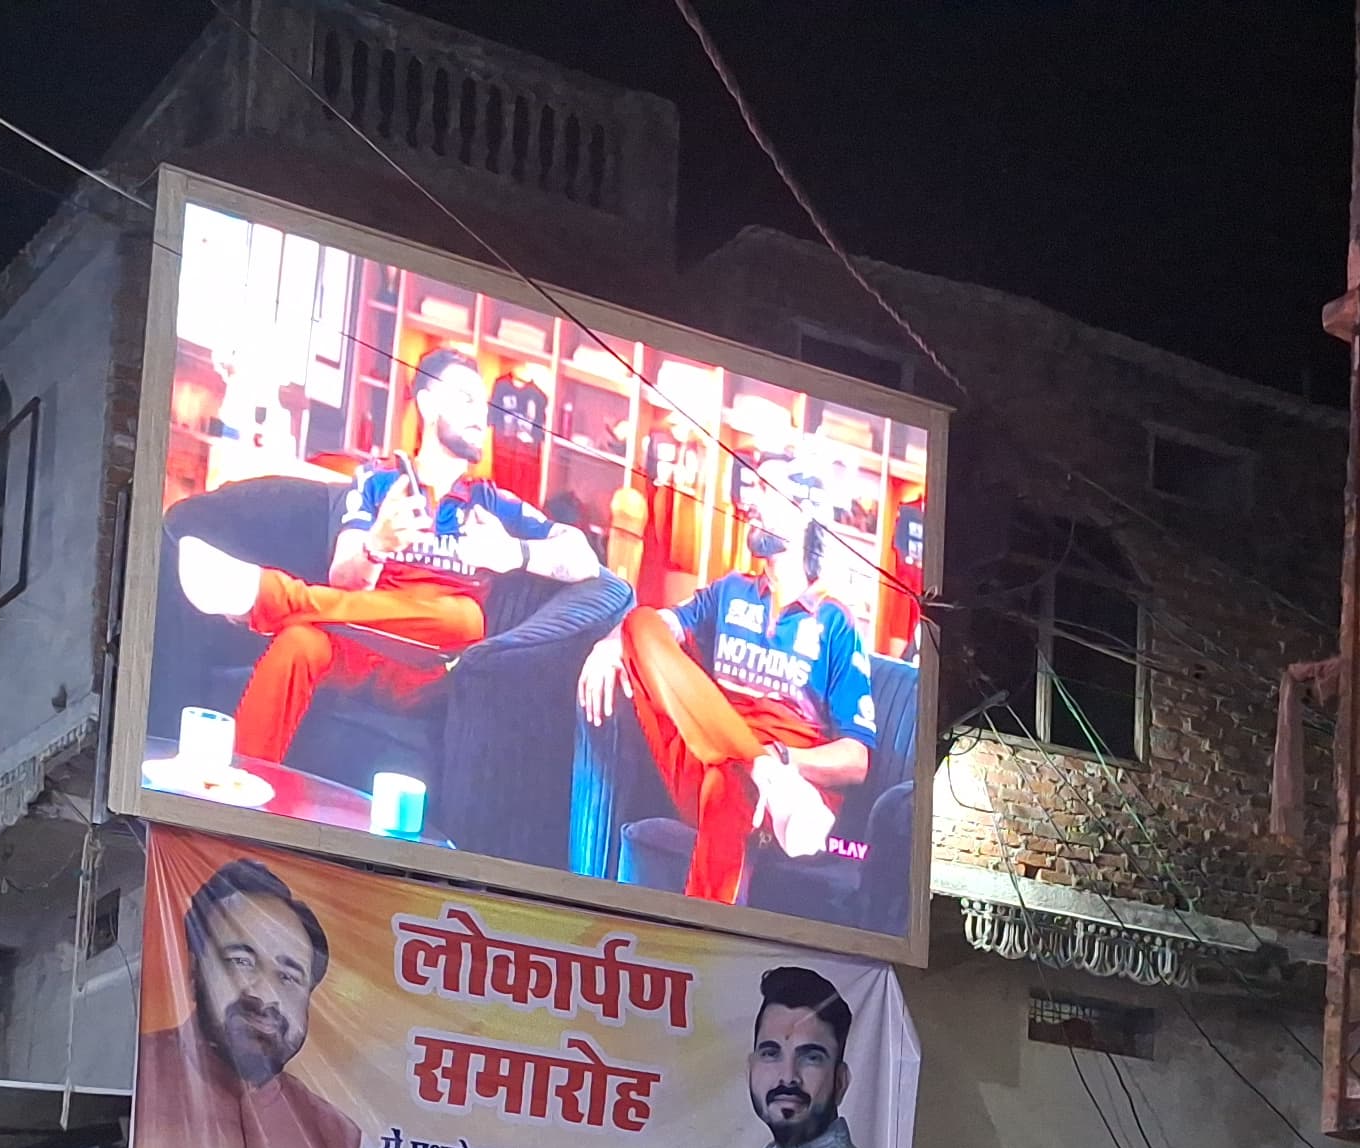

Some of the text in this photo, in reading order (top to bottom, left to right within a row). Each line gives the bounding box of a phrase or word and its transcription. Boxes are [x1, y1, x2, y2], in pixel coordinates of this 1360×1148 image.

[828, 838, 868, 859] PLAY
[397, 911, 692, 1028] लोकार्पण
[413, 1033, 661, 1131] समारोह
